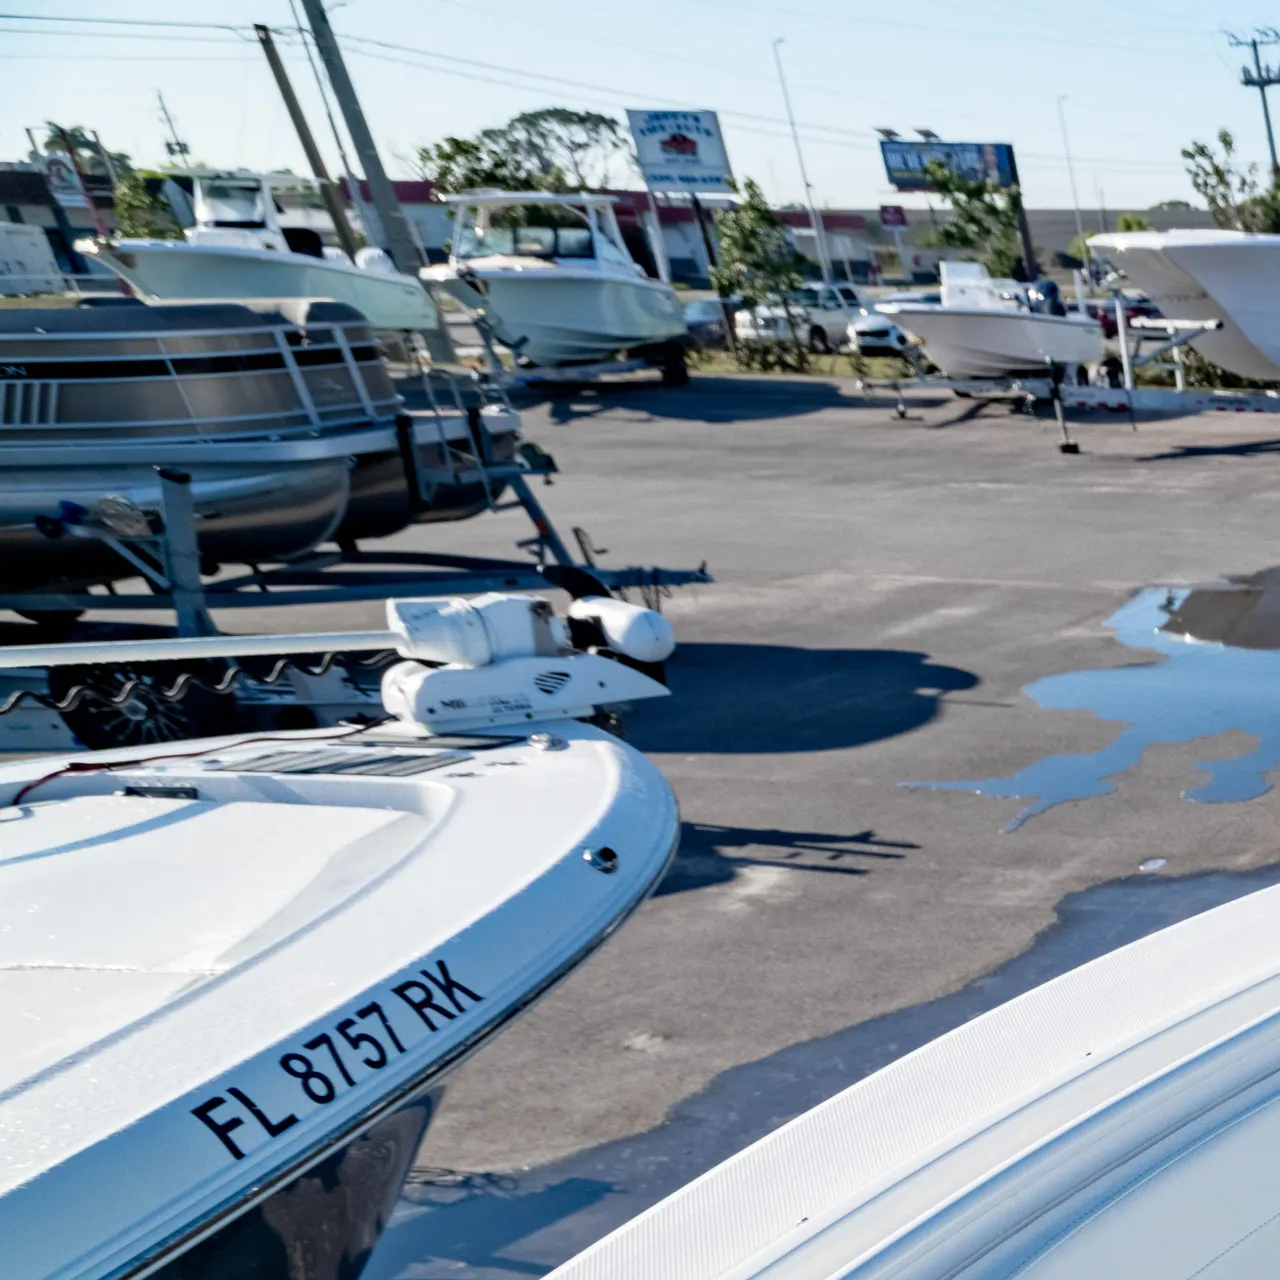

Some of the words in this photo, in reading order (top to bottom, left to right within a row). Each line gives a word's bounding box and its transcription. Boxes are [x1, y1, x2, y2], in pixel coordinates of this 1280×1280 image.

[190, 1086, 300, 1160] FL
[279, 1001, 407, 1105] 8757
[390, 959, 487, 1032] RK
